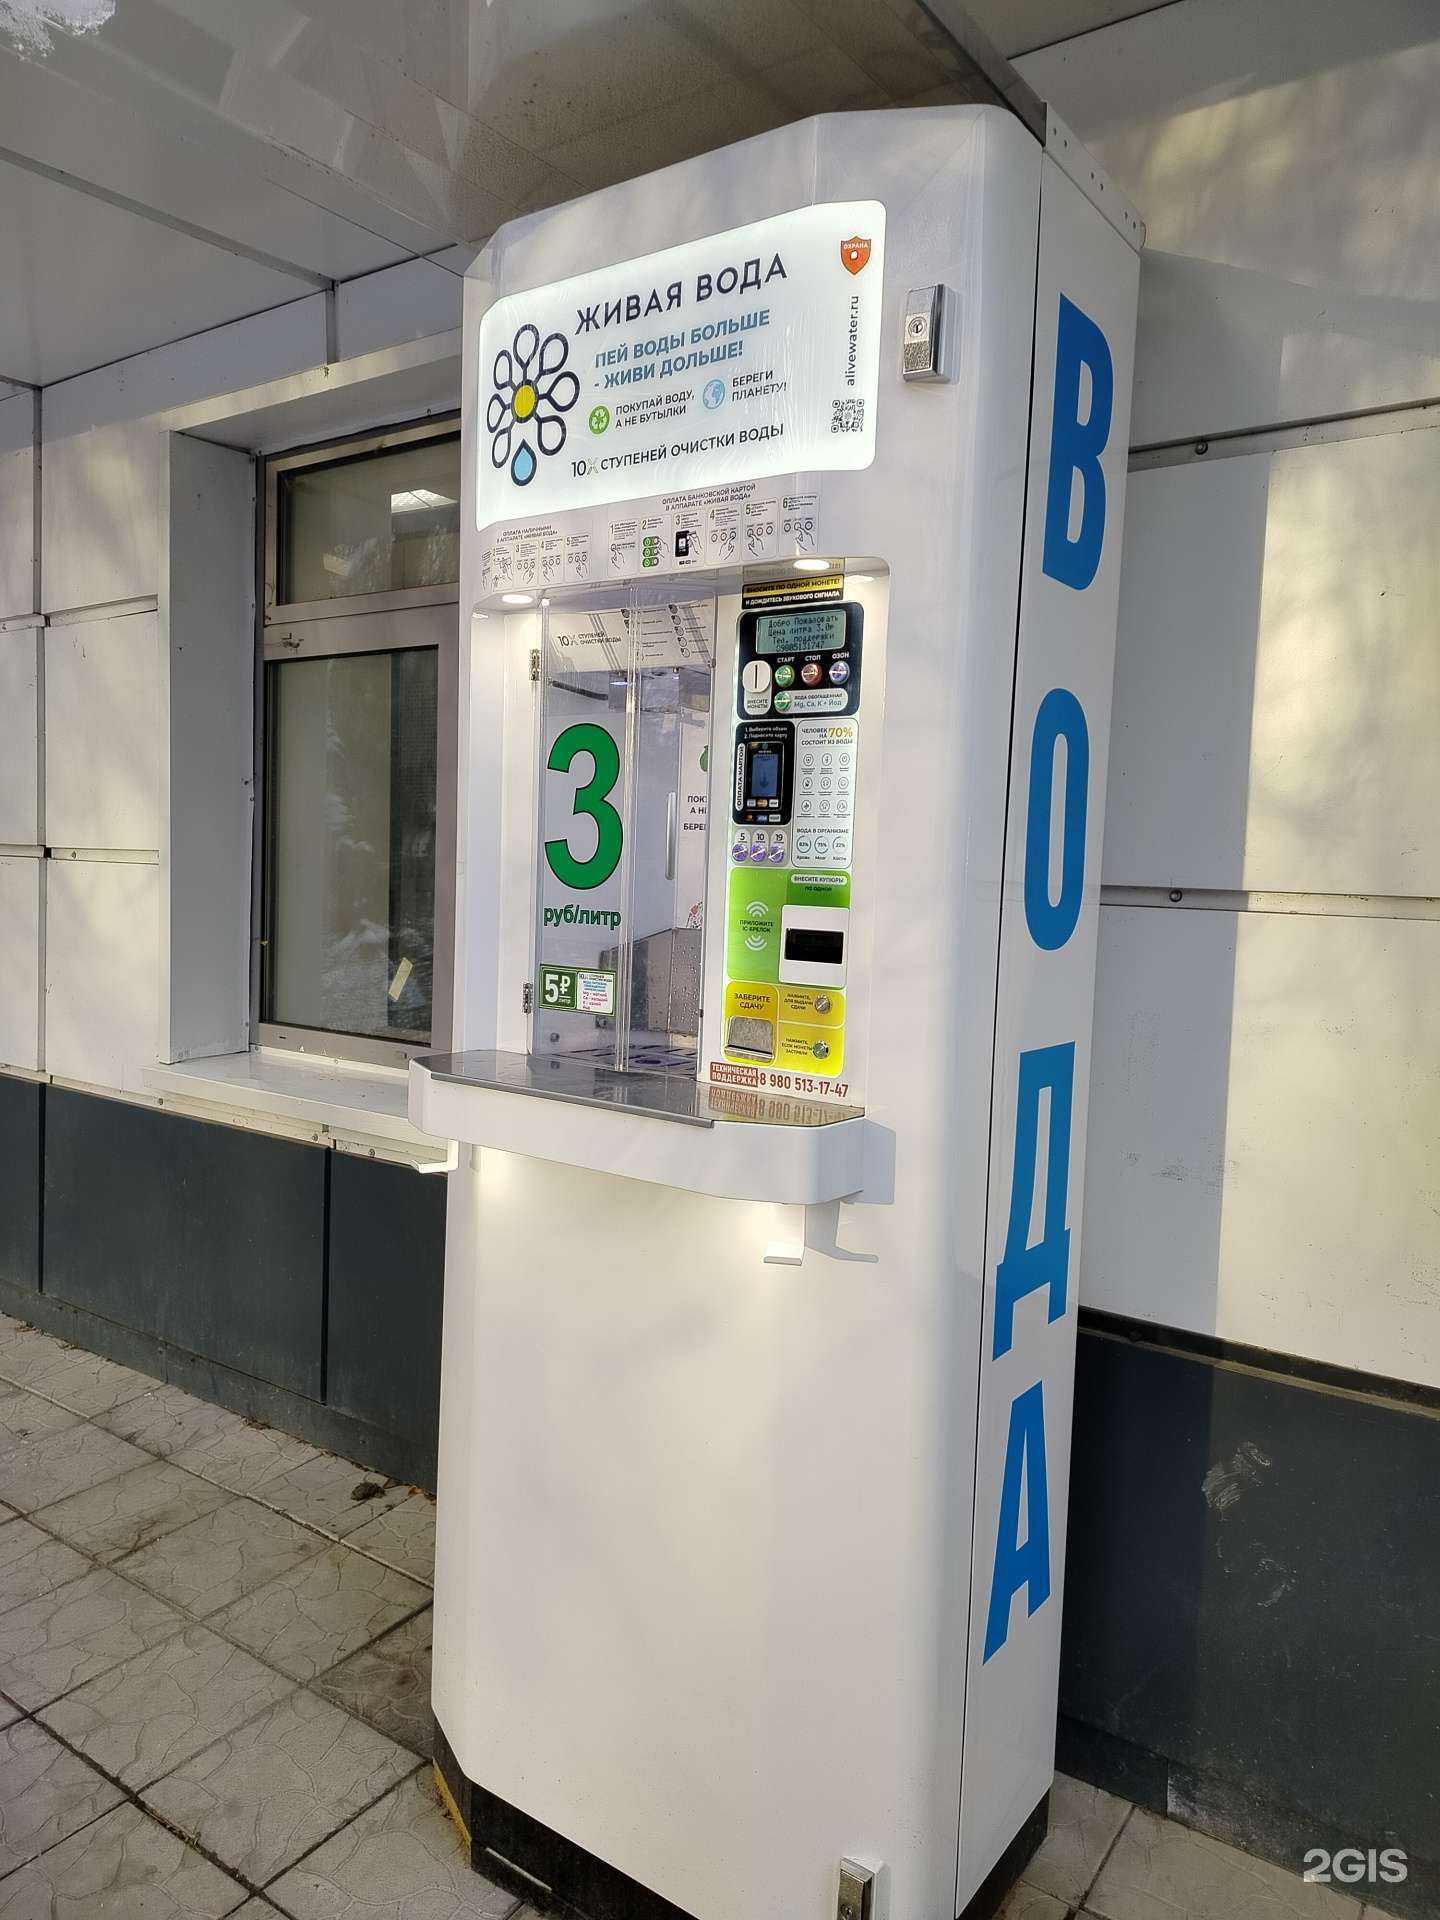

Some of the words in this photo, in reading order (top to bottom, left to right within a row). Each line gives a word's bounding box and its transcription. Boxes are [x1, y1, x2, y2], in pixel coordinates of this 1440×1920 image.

[575, 281, 682, 335] ЖИВАЯ
[697, 253, 787, 302] ВОДА
[595, 343, 628, 368] ПЕЙ
[634, 332, 684, 359] ВОДЫ
[691, 309, 770, 344] БОЛЬШЕ
[845, 296, 859, 386] alivewater.ru
[605, 365, 654, 388] ЖИВИ
[660, 341, 743, 377] ДОЛЬШЕ!
[733, 370, 773, 387] БЕРЕГИ
[732, 382, 787, 401] ПЛАНЕТУ!
[616, 396, 662, 415] ПОКУПАЙ
[666, 389, 695, 403] ВОДУ,
[616, 420, 622, 428] А
[625, 416, 637, 426] НЕ
[640, 406, 686, 423] БУТЫЛКИ
[601, 446, 667, 470] СТУПЕНЕЙ
[672, 433, 734, 456] ОЧИСТКИ
[740, 424, 784, 443] ВОДЫ
[662, 496, 686, 504] ОПЛАТА
[688, 488, 730, 501] БАНКОВСКОЙ
[731, 483, 756, 494] КАРТОЙ
[671, 501, 702, 510] АППАРАТЕ
[746, 504, 750, 515] 5
[783, 498, 788, 508] 6
[675, 516, 680, 525] 3
[710, 509, 715, 519] 4
[610, 524, 614, 534] 1
[642, 520, 647, 530] 2
[500, 533, 523, 542] АППАРАТЕ
[503, 529, 522, 537] ОПЛАТА
[787, 581, 811, 589] ОДНОЙ
[812, 579, 840, 587] МОНЕТЕ!
[750, 596, 782, 605] ДОЖДИТЕСЬ
[783, 593, 813, 602] ЗВУКОВОГО
[829, 727, 852, 737] 70%
[544, 723, 624, 890] 3
[543, 905, 622, 931] руб/литр
[982, 293, 1113, 1665] ВОДА
[734, 993, 771, 1003] ЗАБЕРИТЕ
[740, 1002, 764, 1010] СДАЧУ
[712, 1063, 756, 1076] ТЕХНИЧЕСКАЯ
[712, 1072, 757, 1086] ПОДДЕРЖКА
[760, 1073, 766, 1085] 8
[770, 1074, 791, 1089] 980
[795, 1078, 849, 1097] 513-17-47
